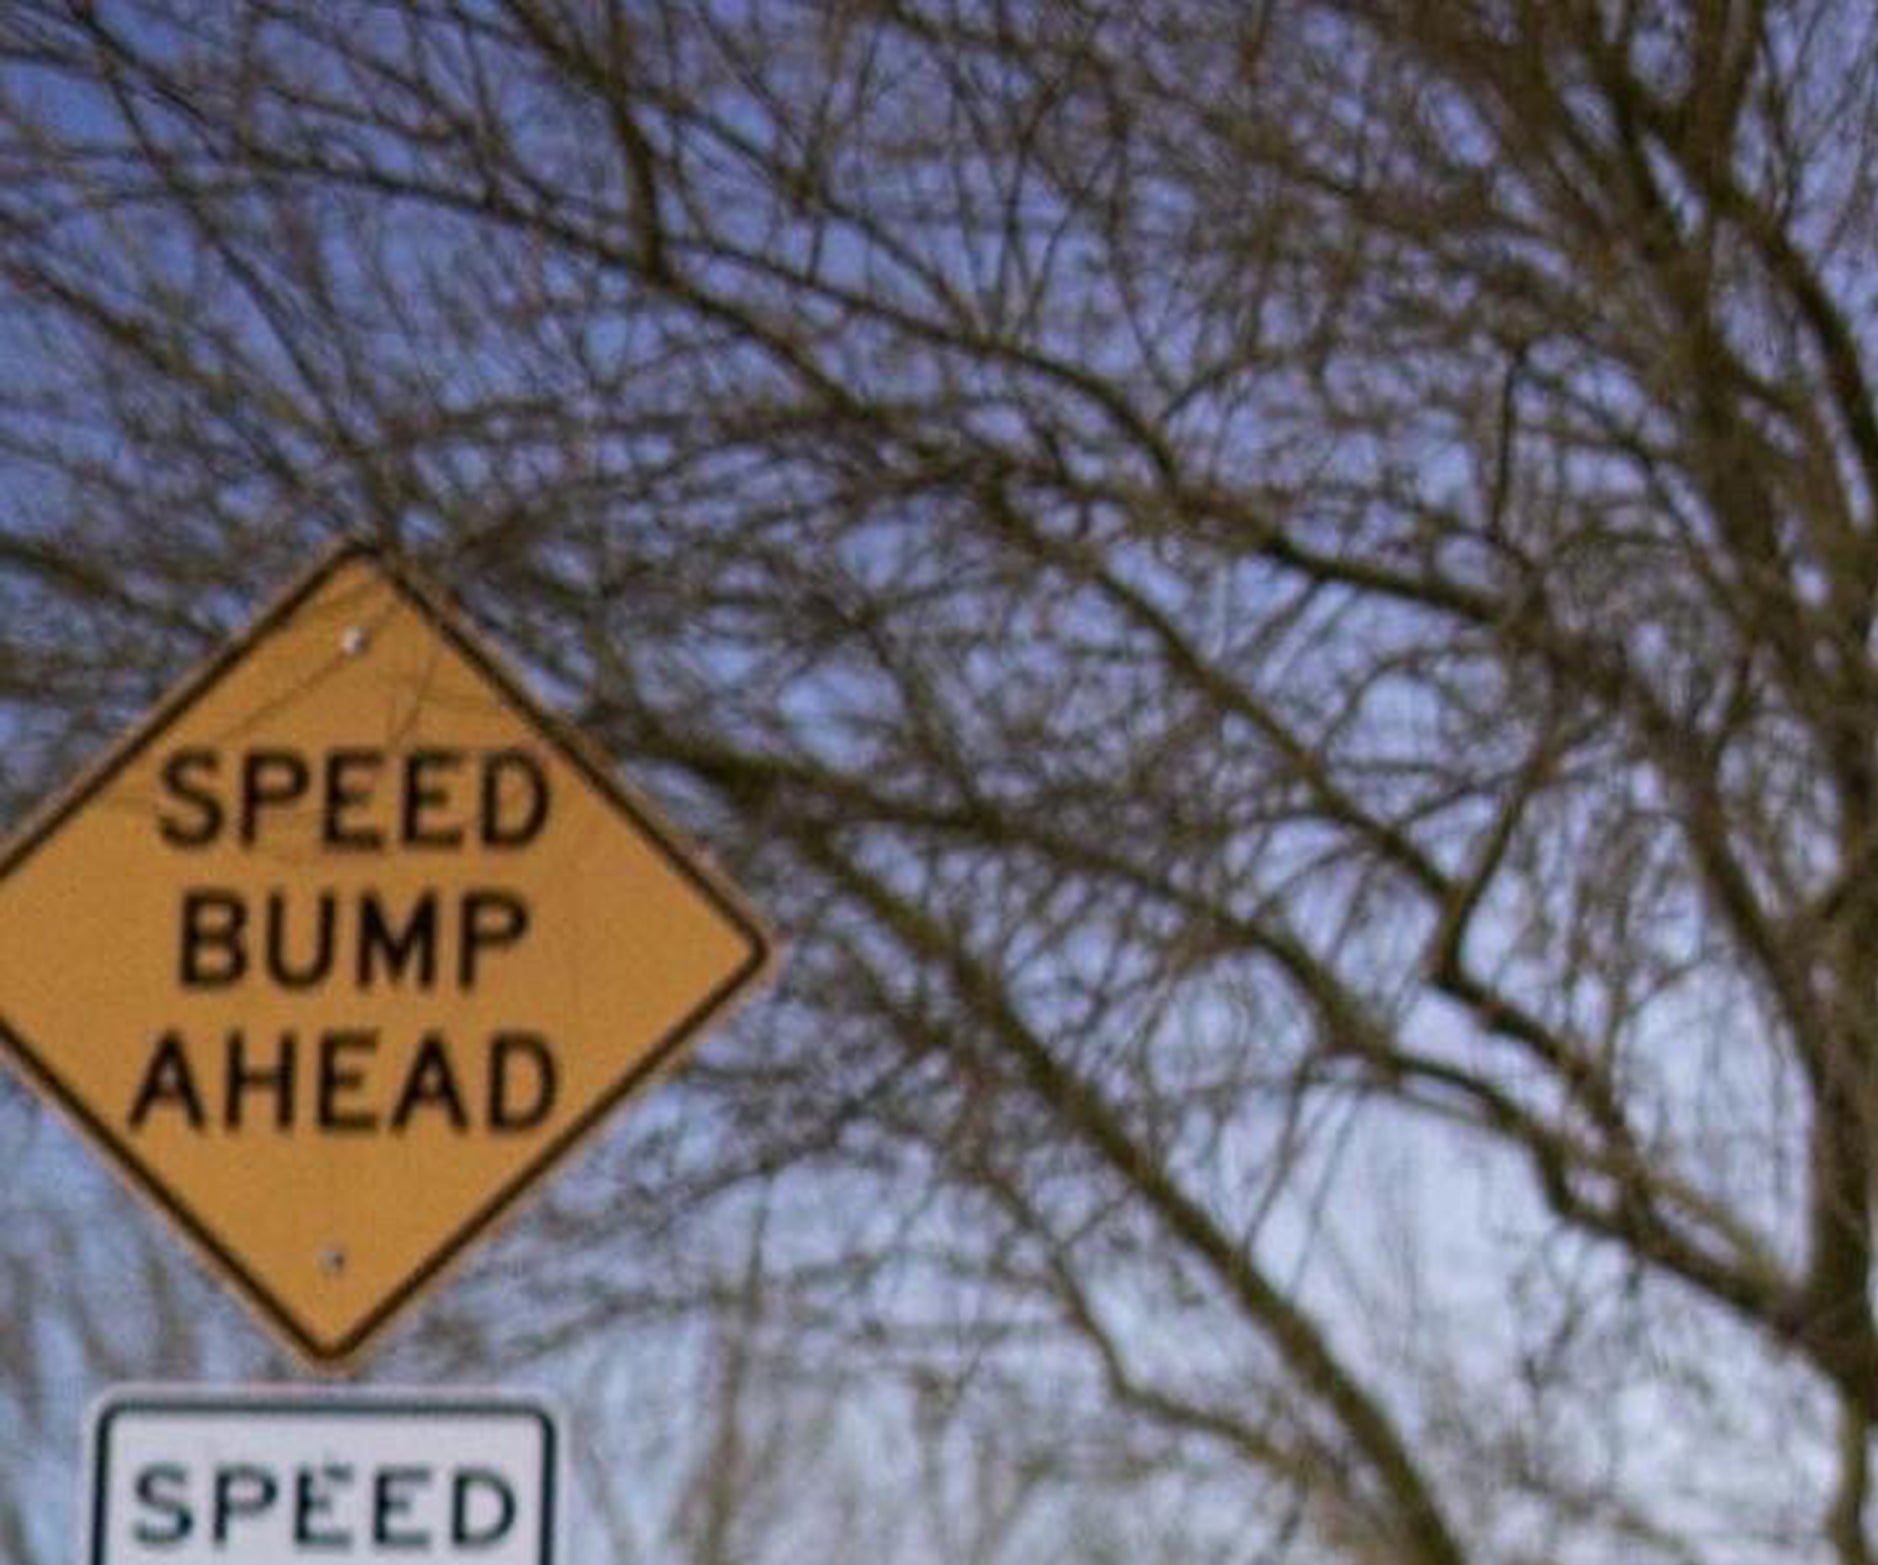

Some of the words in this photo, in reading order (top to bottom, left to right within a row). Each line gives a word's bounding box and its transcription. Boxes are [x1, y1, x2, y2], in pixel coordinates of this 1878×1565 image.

[156, 746, 552, 852] SPEED
[177, 888, 529, 990] BUMP
[129, 1031, 559, 1135] AHEAD
[133, 1461, 518, 1552] SPEED
